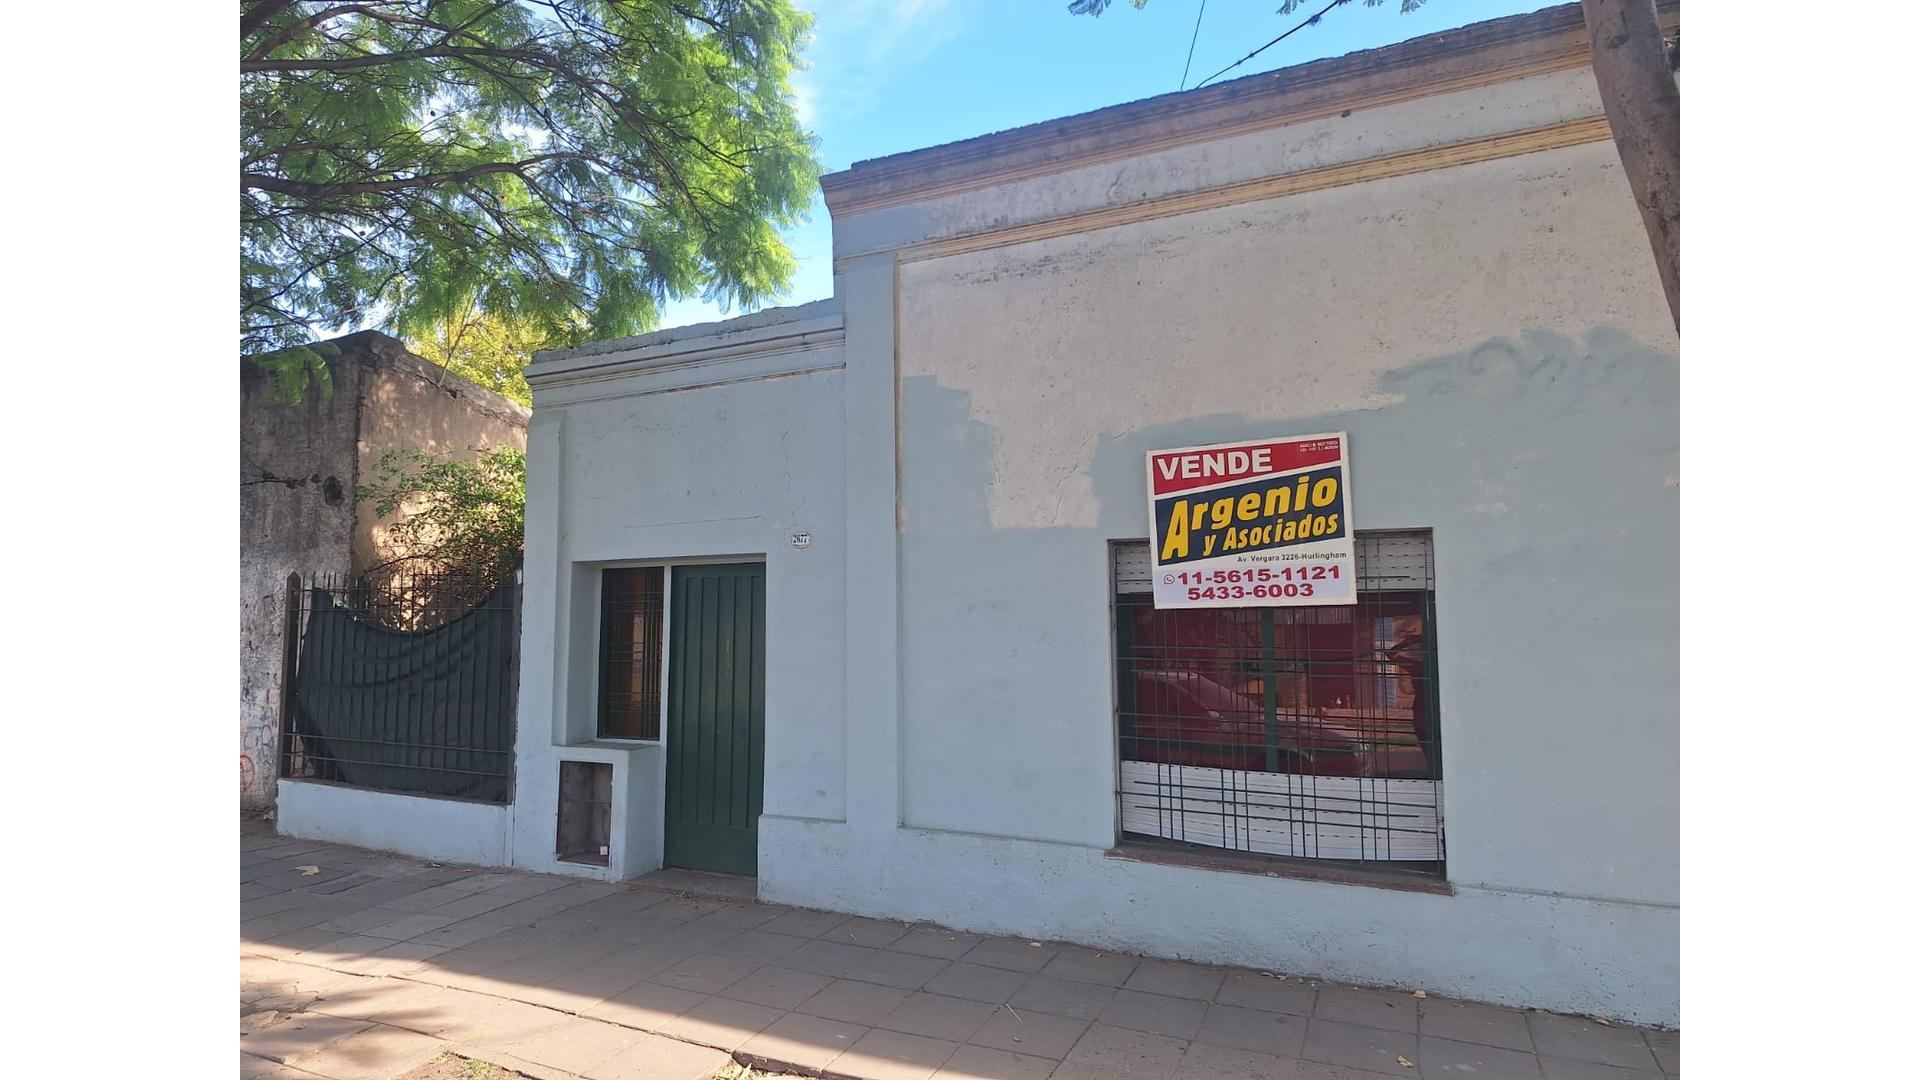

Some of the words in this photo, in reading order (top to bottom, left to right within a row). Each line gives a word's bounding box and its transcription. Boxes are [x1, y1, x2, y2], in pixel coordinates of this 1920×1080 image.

[1157, 448, 1273, 481] VENDE
[1161, 475, 1338, 561] Argenio
[1202, 534, 1217, 557] y
[1223, 513, 1339, 551] Asociados
[1250, 554, 1280, 563] Vergara
[1177, 565, 1340, 585] 11-5615-1121
[1187, 583, 1314, 601] 5433-6003
